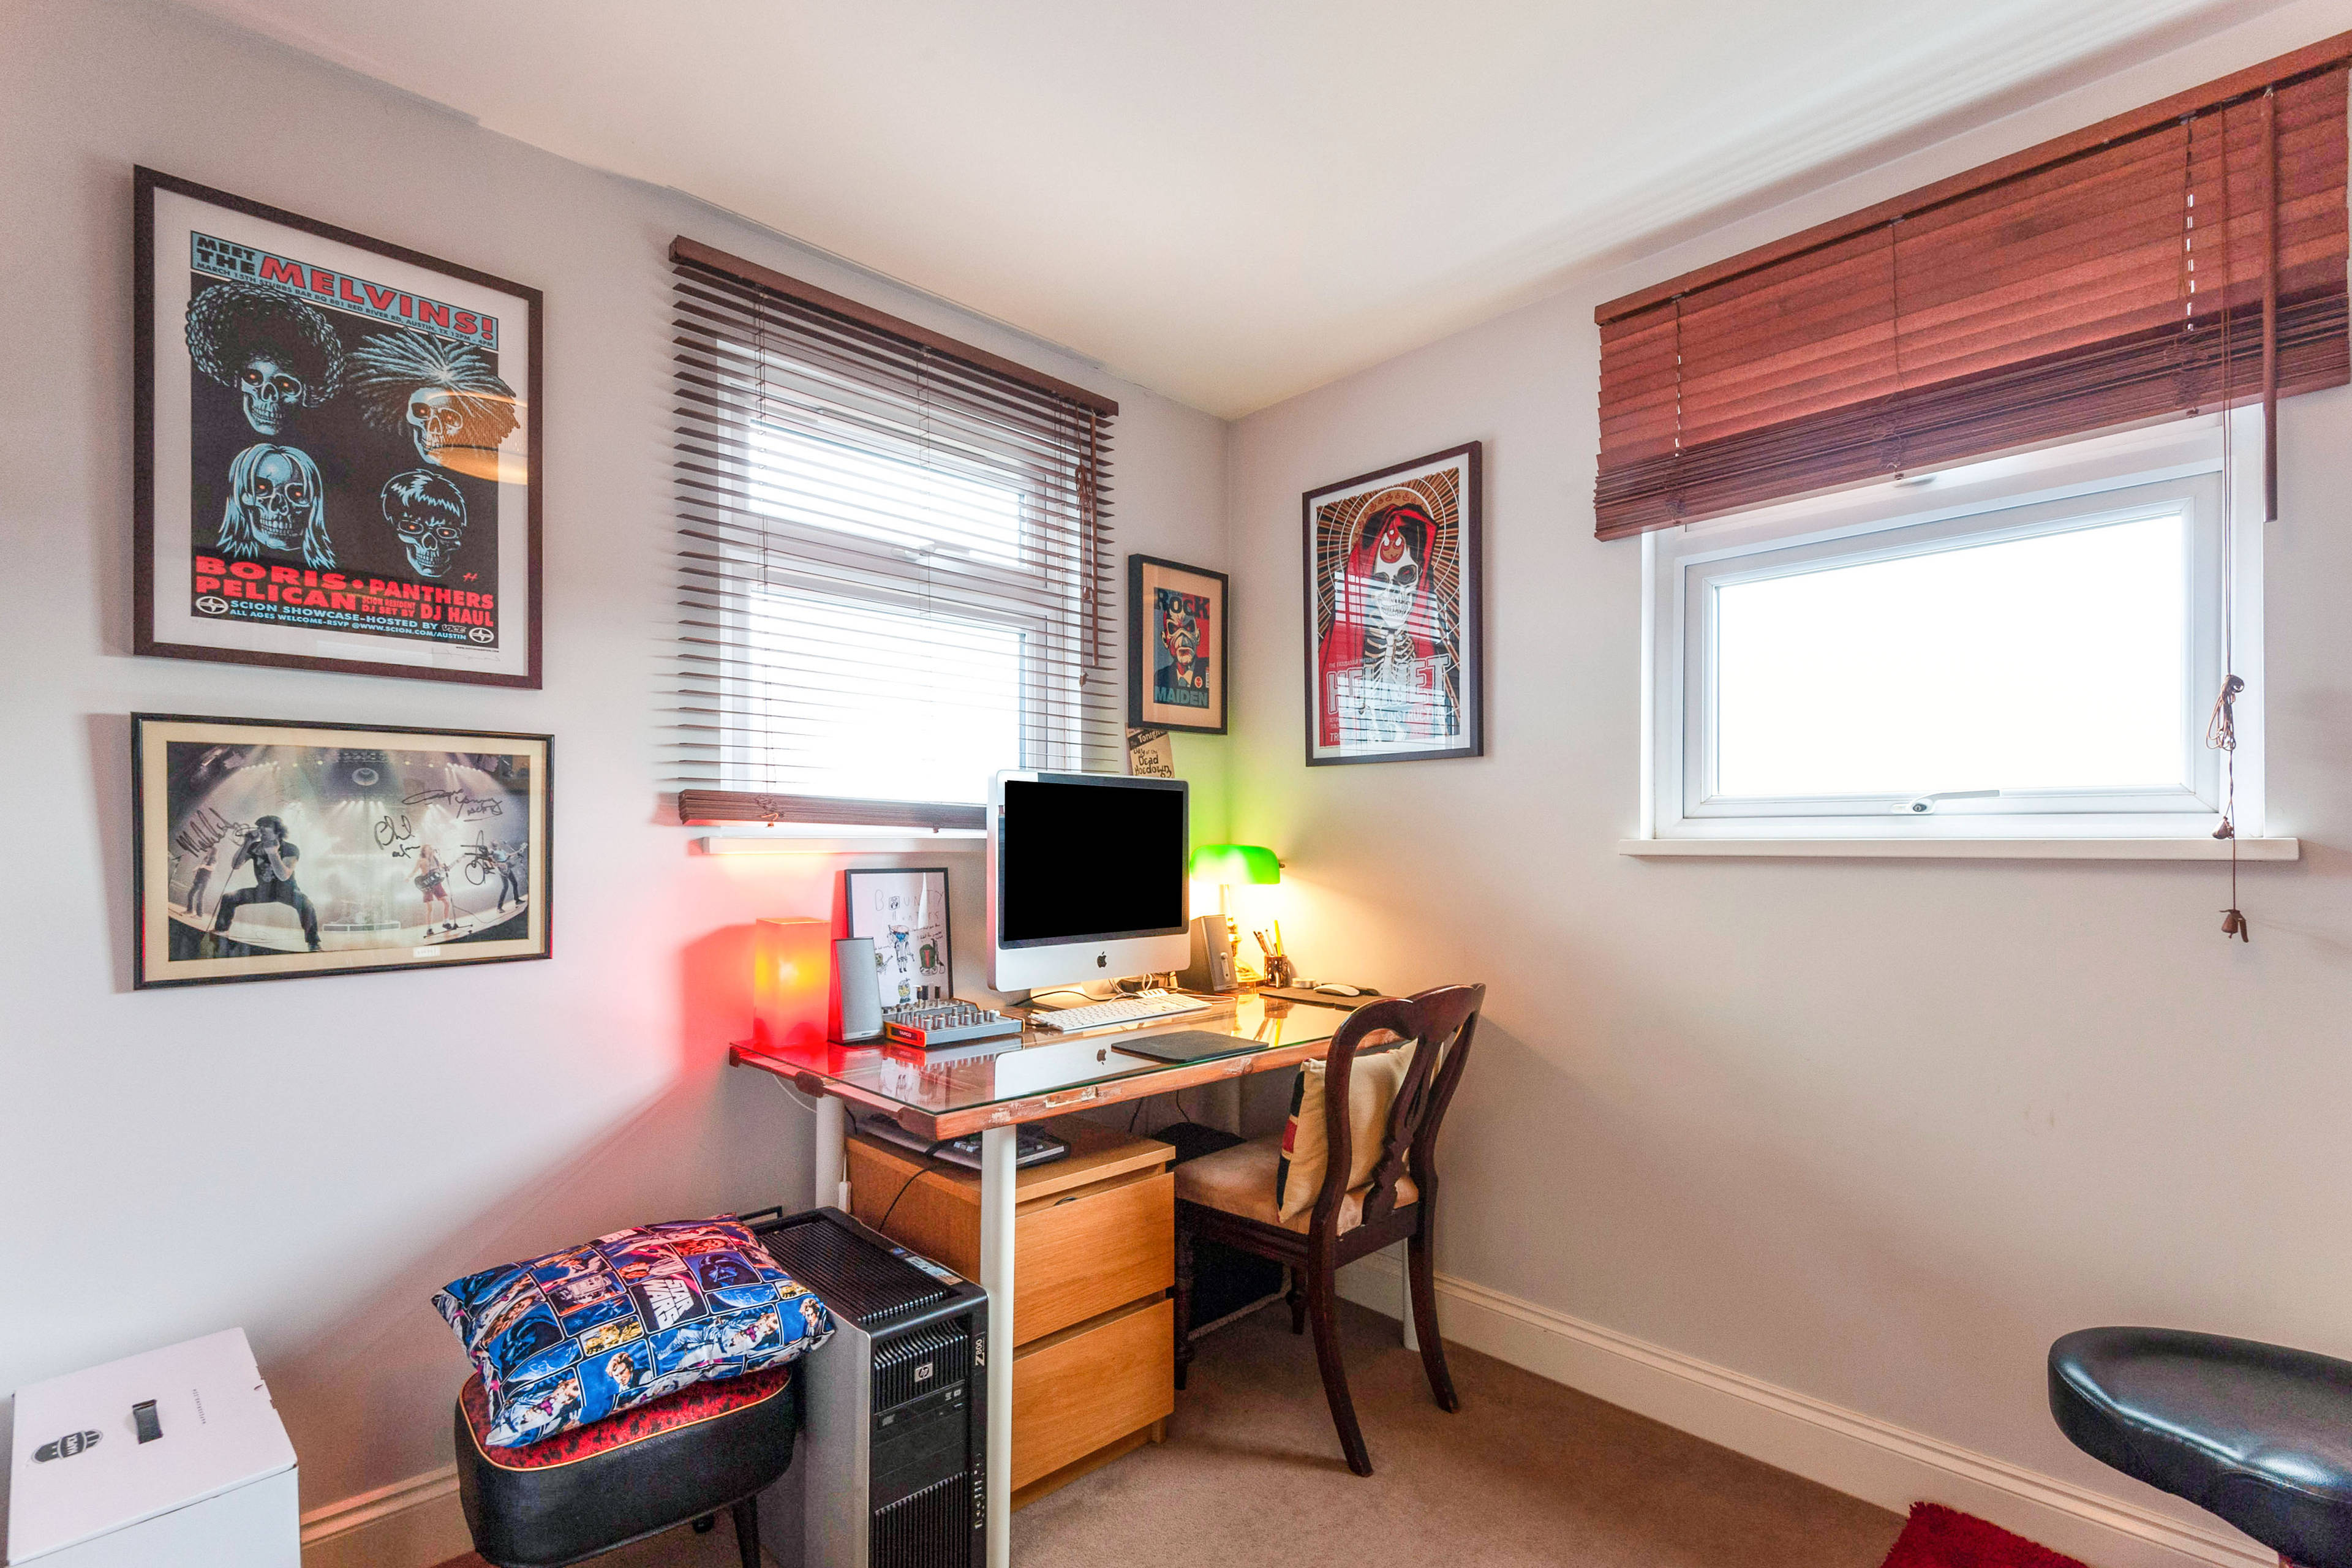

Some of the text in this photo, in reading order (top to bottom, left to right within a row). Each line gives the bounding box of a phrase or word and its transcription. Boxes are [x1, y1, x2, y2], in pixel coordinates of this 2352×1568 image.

[197, 237, 255, 261] MEET
[197, 248, 255, 275] THE
[197, 263, 230, 276] MARCH
[234, 273, 256, 283] 15TH
[260, 279, 292, 293] STUBBS
[295, 289, 312, 298] BAR
[366, 309, 388, 318] RIVER
[260, 256, 493, 341] MELVINS!
[196, 556, 347, 590] BORIS
[196, 576, 356, 611] PELICAN
[369, 578, 494, 609] PANTHERS
[1154, 589, 1210, 620] ROCK
[230, 600, 277, 612] SCION
[422, 622, 439, 630] BY
[361, 605, 415, 617] DJ SET BY
[420, 603, 494, 627] DJ HAUL
[1155, 686, 1208, 706] MAIDEN
[1134, 748, 1145, 758] Day
[1139, 755, 1159, 766] Dead
[641, 1279, 680, 1330] WARS
[665, 1279, 695, 1316] STAR
[975, 1338, 985, 1366] Z800
